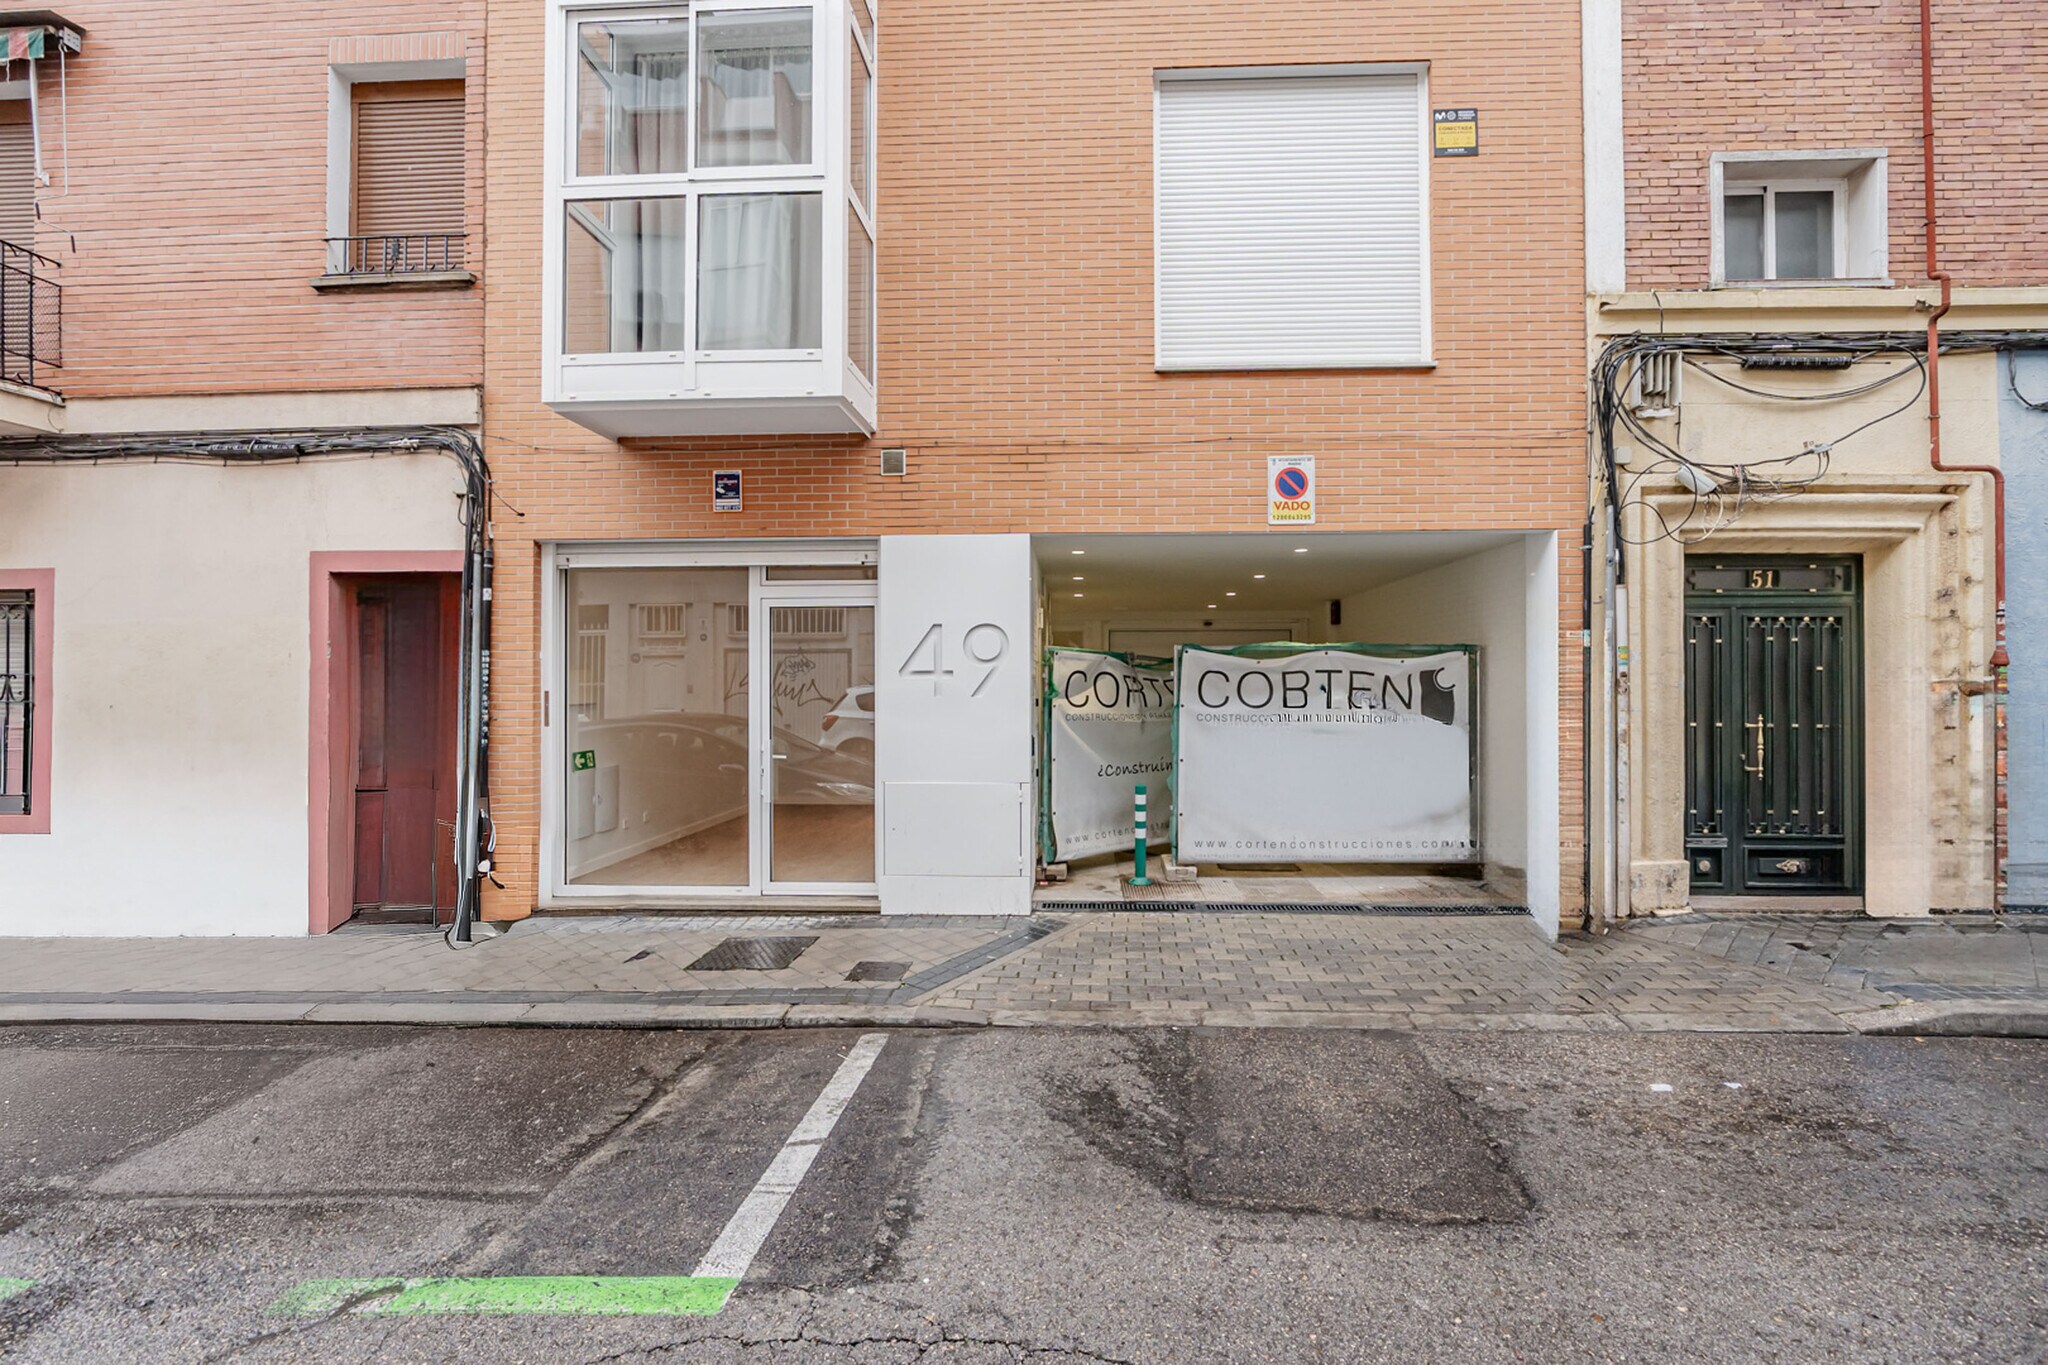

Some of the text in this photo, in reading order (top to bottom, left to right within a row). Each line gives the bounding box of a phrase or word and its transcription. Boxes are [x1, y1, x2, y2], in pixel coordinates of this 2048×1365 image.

[1273, 501, 1311, 511] VADO
[1751, 570, 1773, 588] 51
[898, 622, 1010, 698] 49
